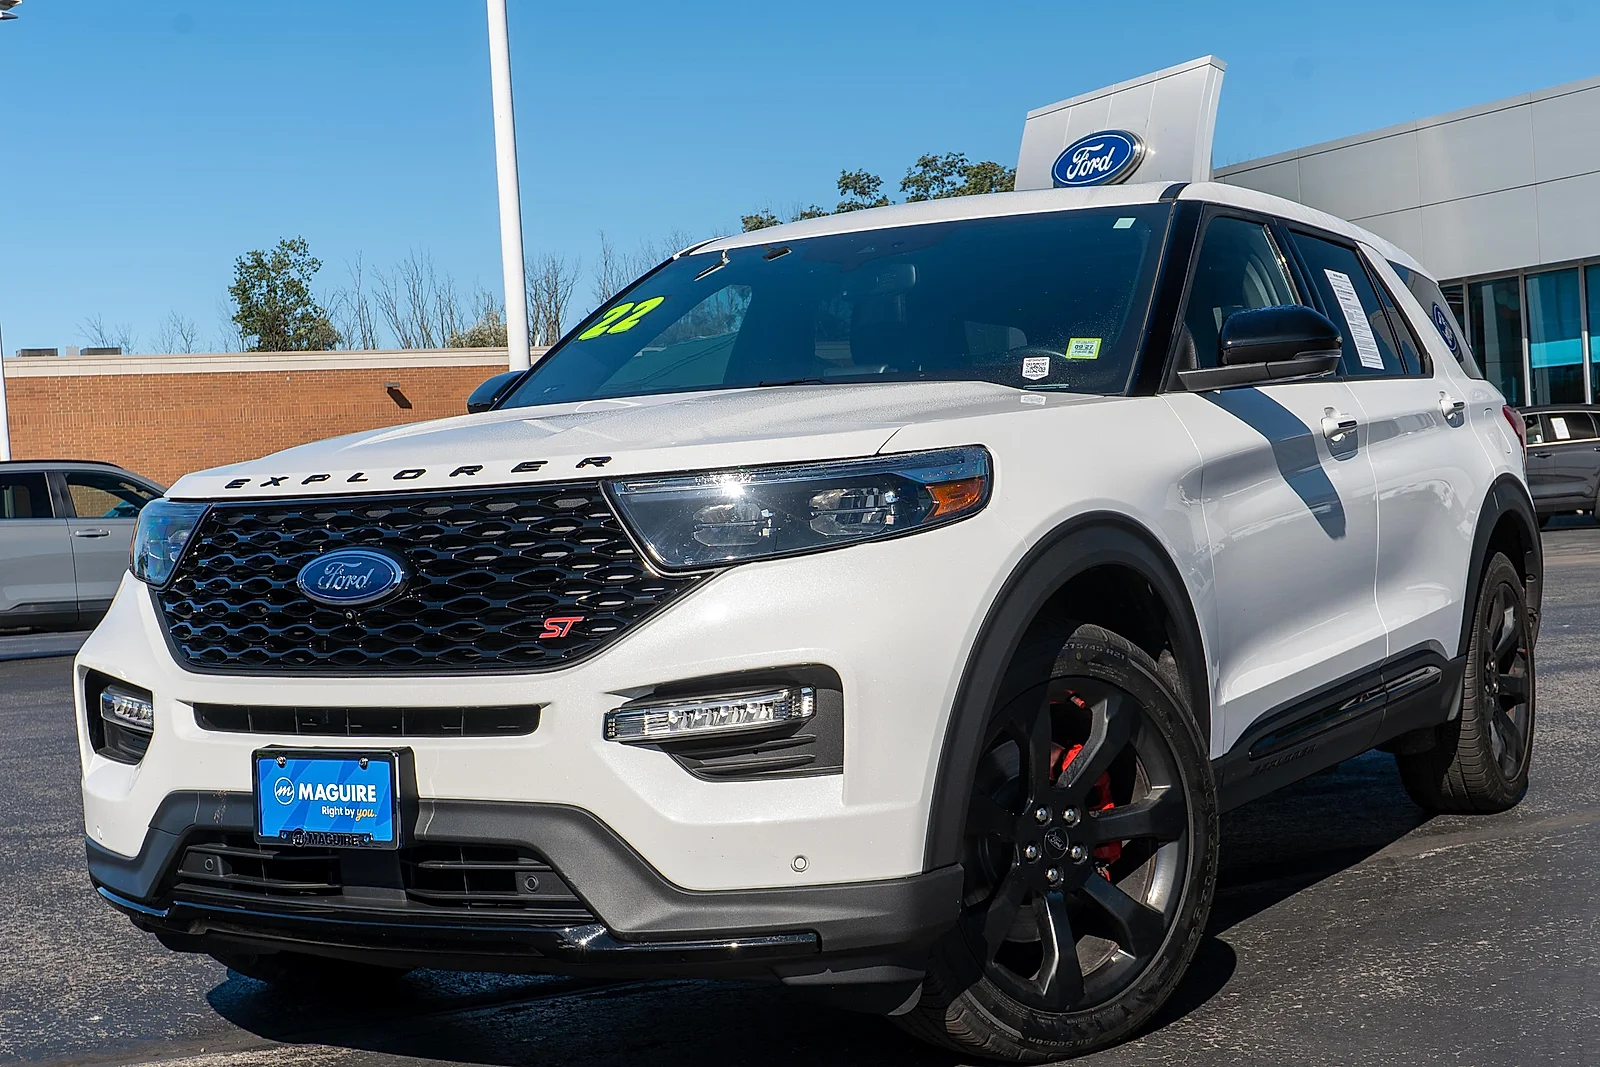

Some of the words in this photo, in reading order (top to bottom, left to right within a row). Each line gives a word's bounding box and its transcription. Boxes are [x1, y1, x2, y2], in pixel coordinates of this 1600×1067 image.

[1066, 143, 1115, 180] Ford
[577, 296, 665, 341] 22
[224, 455, 613, 490] EXPLORER
[317, 561, 375, 590] Ford
[538, 616, 585, 639] ST
[1106, 648, 1126, 660] R21
[298, 782, 377, 803] MAGUIRE
[321, 806, 344, 818] Right
[344, 806, 355, 819] by
[355, 809, 377, 821] you.
[307, 832, 359, 847] MAGUIRE
[1027, 1036, 1074, 1048] Season
[1077, 1037, 1093, 1046] All
